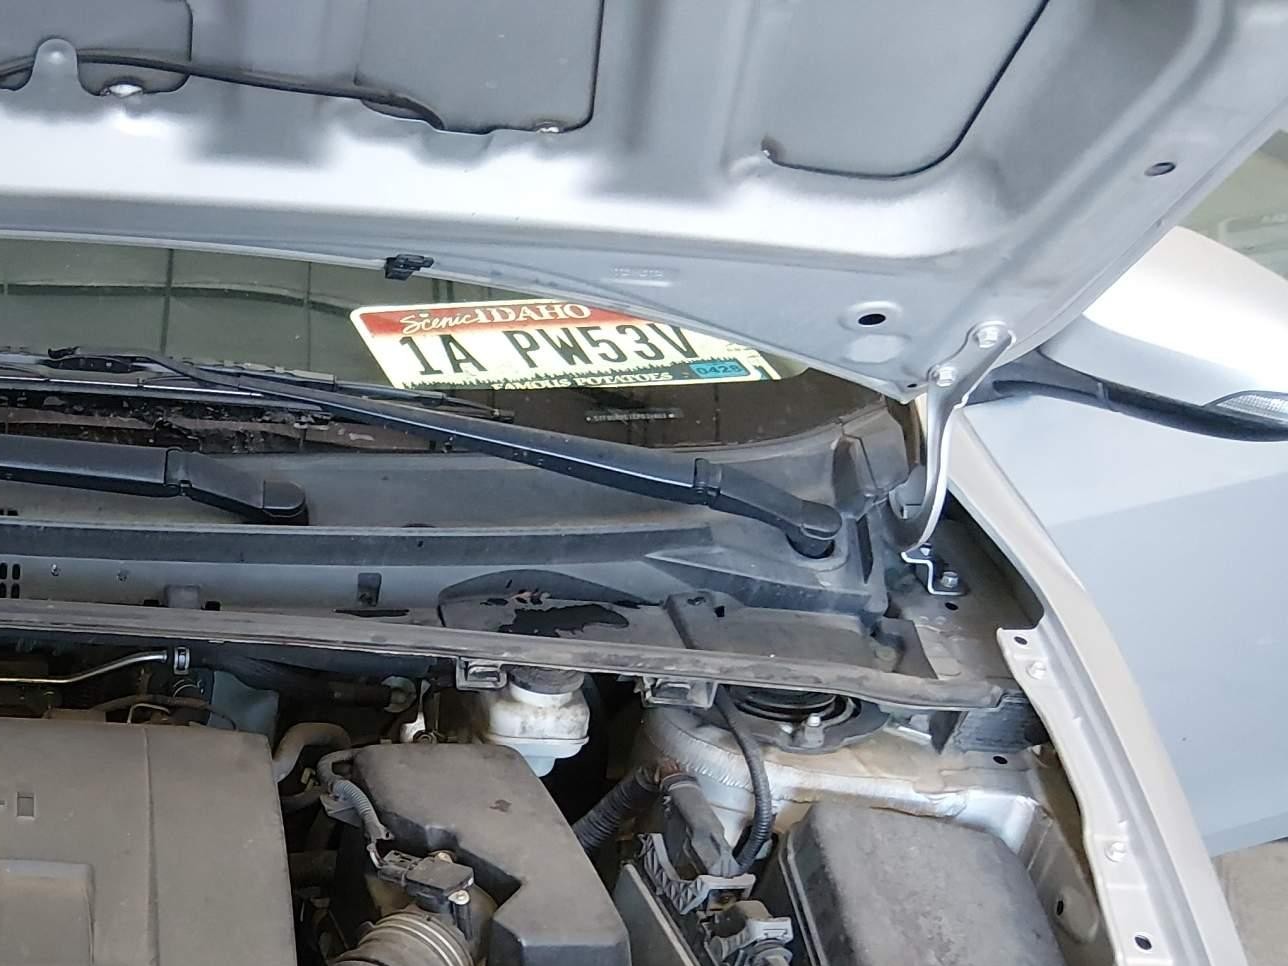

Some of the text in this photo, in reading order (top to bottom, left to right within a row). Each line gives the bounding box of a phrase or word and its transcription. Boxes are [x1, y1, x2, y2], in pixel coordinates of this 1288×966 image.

[400, 303, 592, 335] Scenic IDAHO
[399, 323, 699, 375] 1A PW53V
[573, 372, 673, 386] POTATOES
